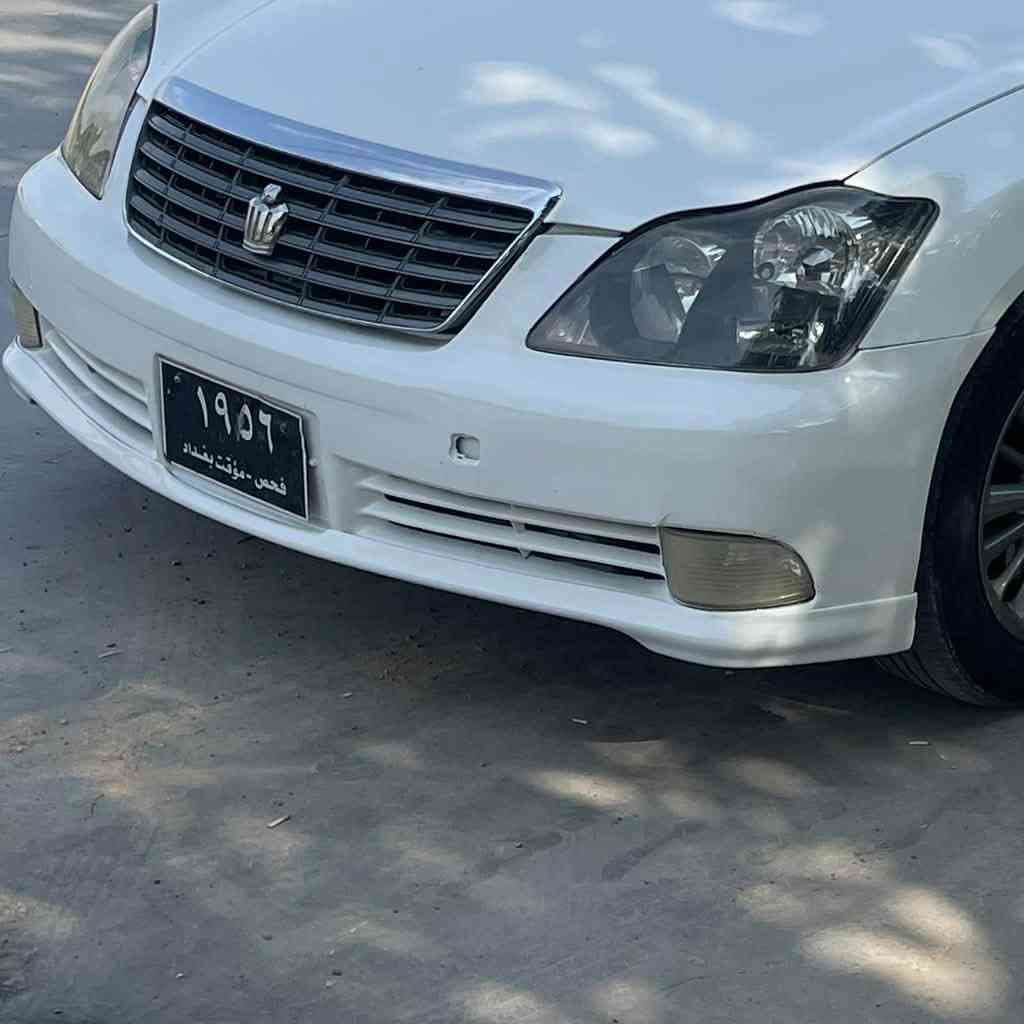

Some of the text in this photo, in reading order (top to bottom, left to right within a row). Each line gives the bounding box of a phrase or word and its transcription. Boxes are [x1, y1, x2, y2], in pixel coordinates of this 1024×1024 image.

[197, 386, 274, 454] ١٩٥٦
[183, 442, 214, 469] بغداد
[254, 476, 287, 496] فحص
